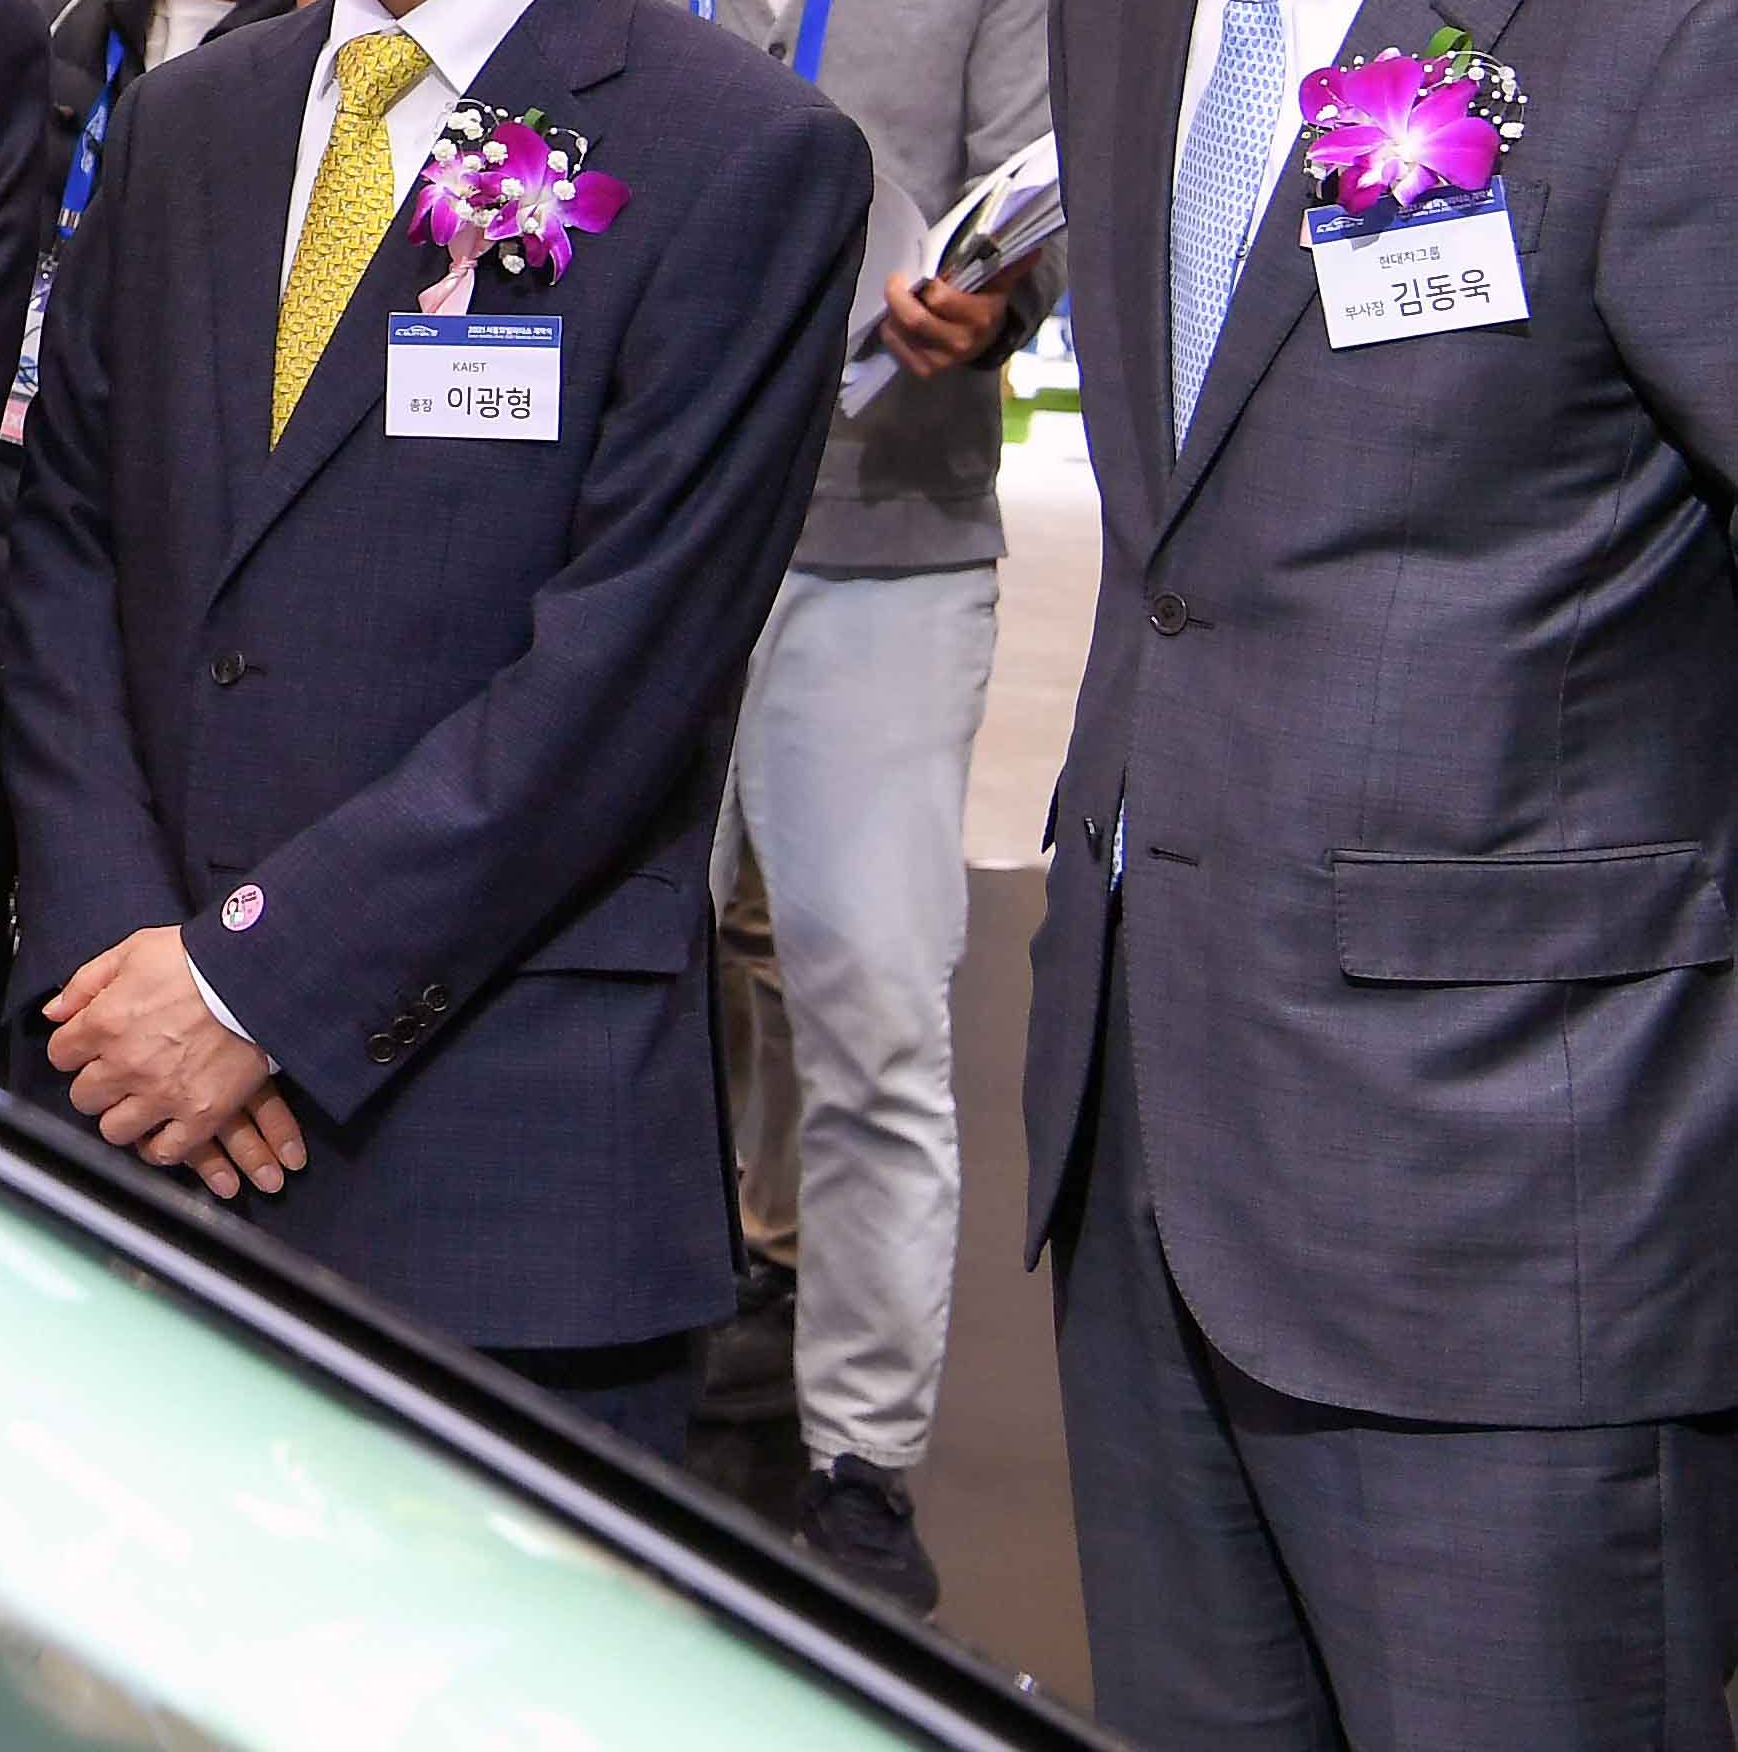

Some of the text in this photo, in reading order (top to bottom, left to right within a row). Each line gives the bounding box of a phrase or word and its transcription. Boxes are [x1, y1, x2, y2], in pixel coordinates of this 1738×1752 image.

[1379, 246, 1441, 269] 현대차그룹
[1345, 269, 1491, 321] 부사장 김동욱
[452, 361, 487, 373] KAIST
[447, 386, 531, 420] 이광형
